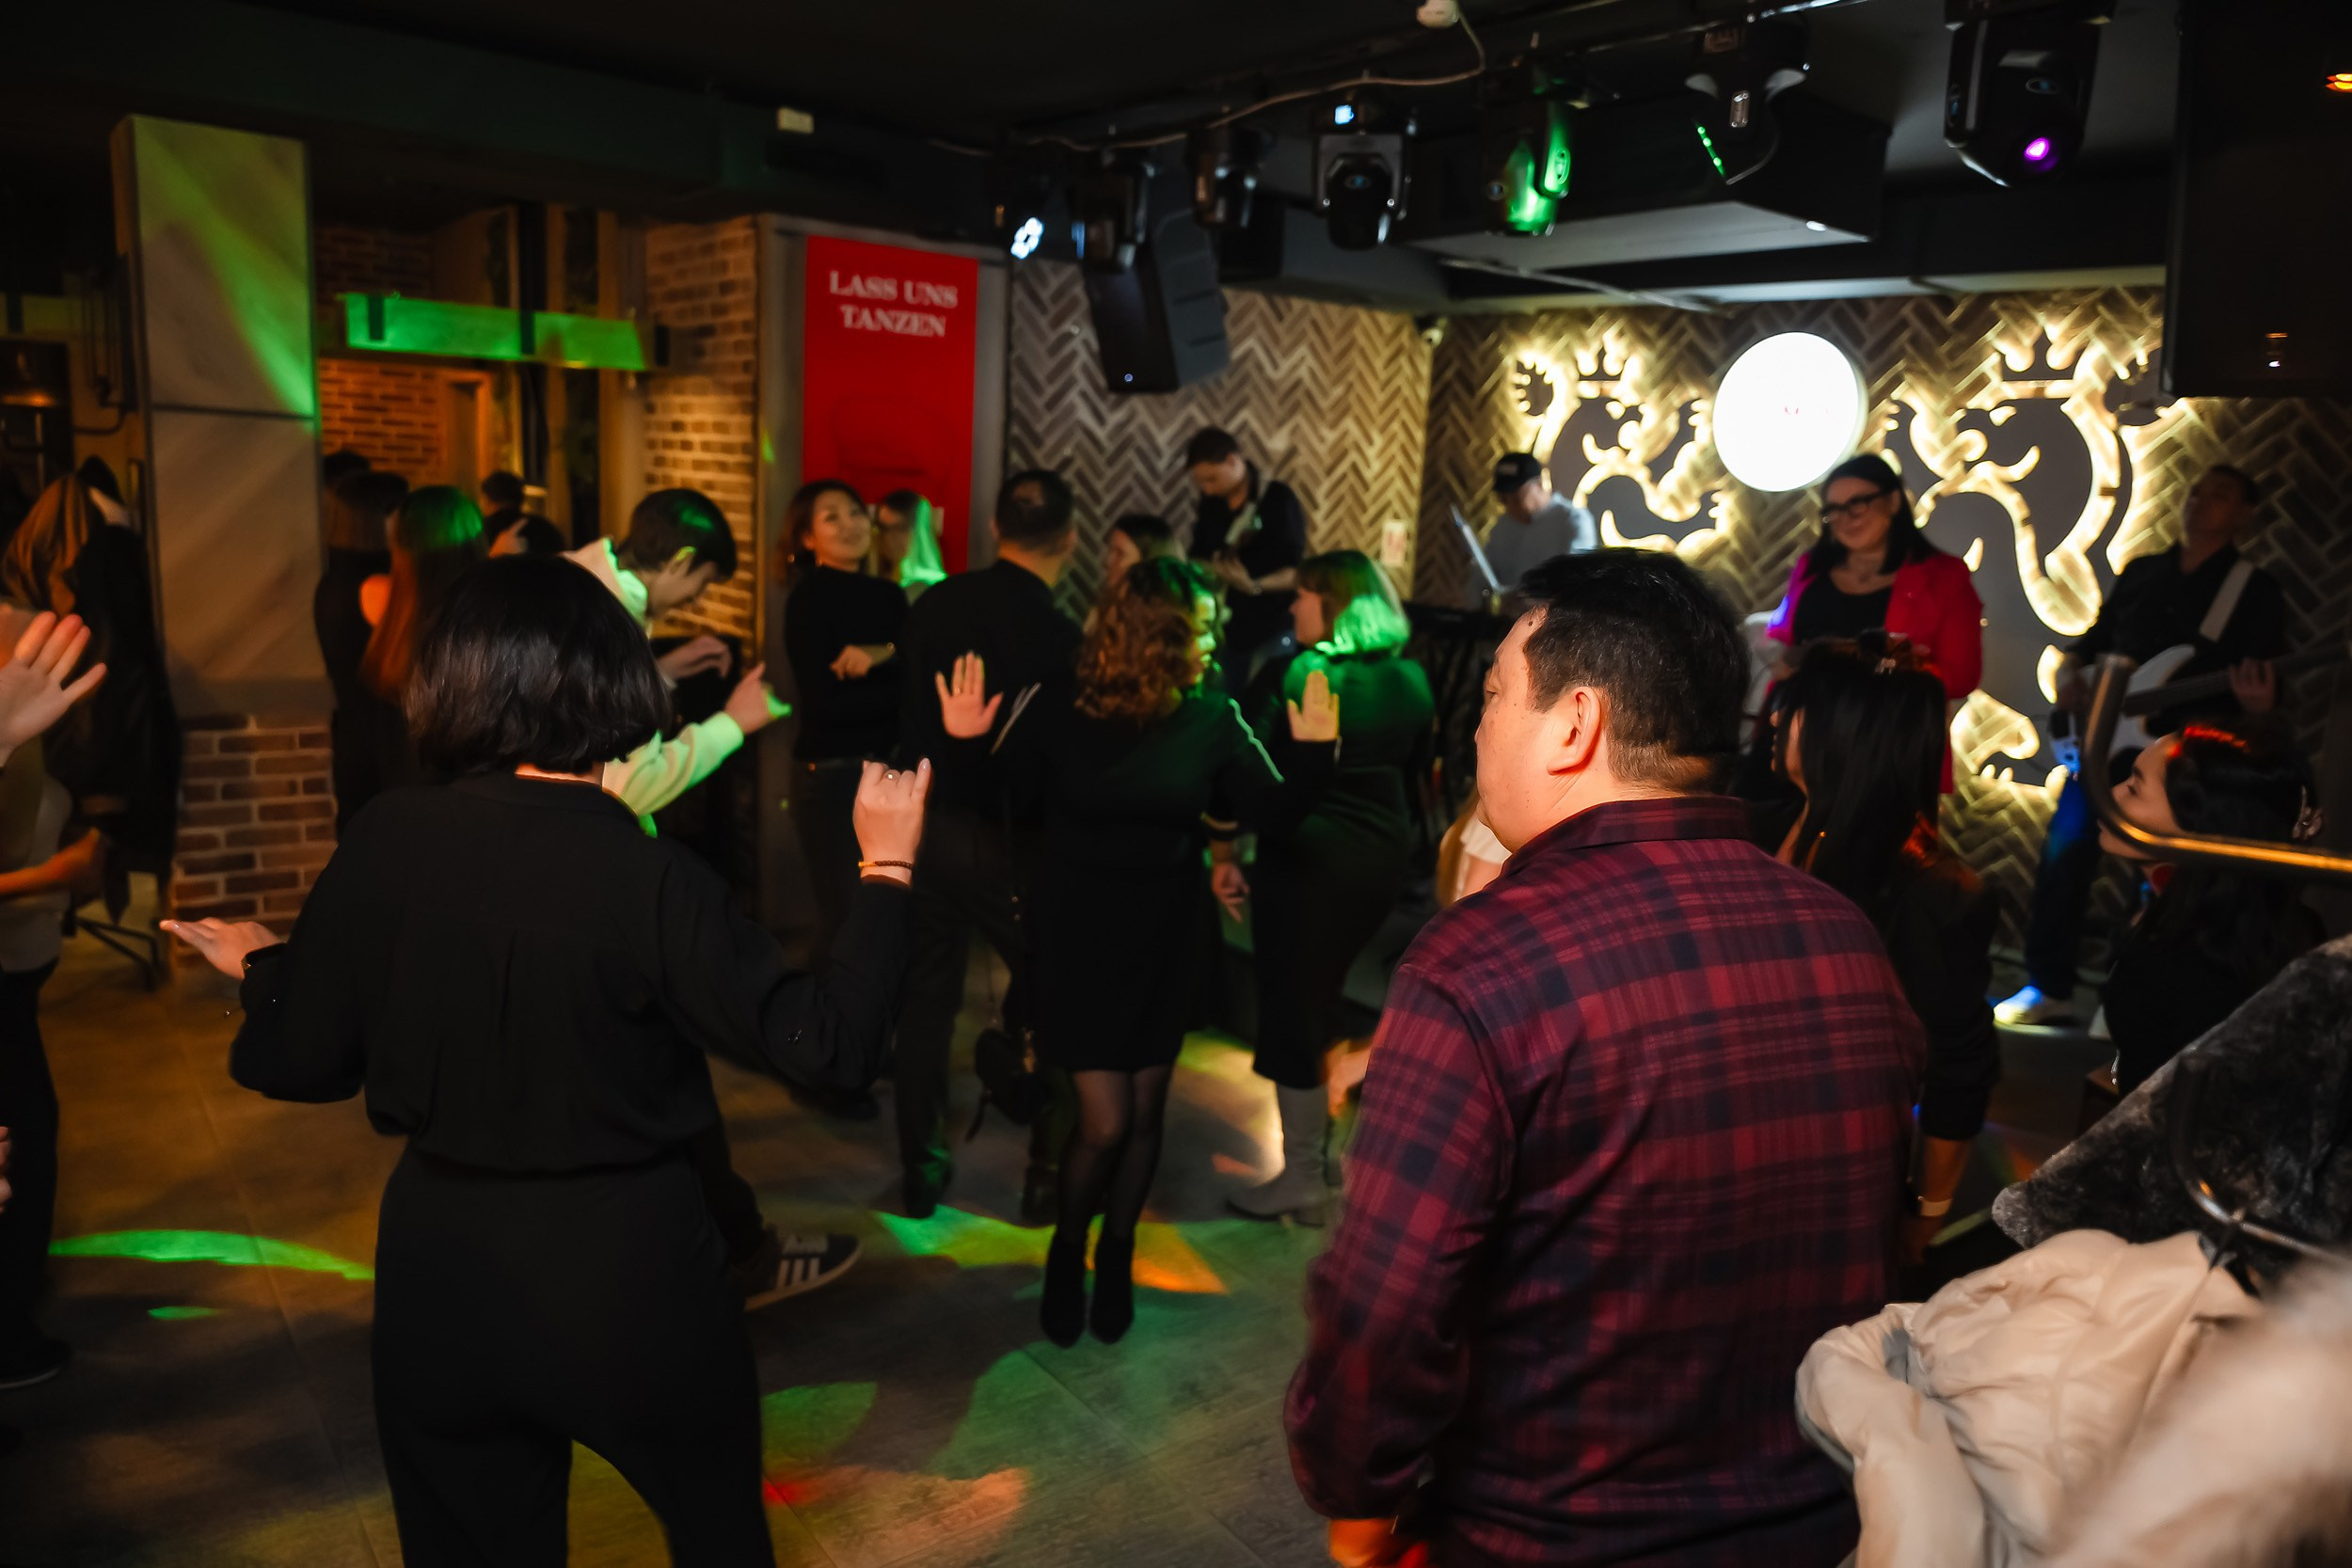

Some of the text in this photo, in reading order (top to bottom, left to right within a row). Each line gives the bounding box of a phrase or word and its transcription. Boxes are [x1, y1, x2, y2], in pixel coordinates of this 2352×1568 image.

[829, 270, 958, 309] LASS UNS
[839, 304, 946, 338] TANZEN
